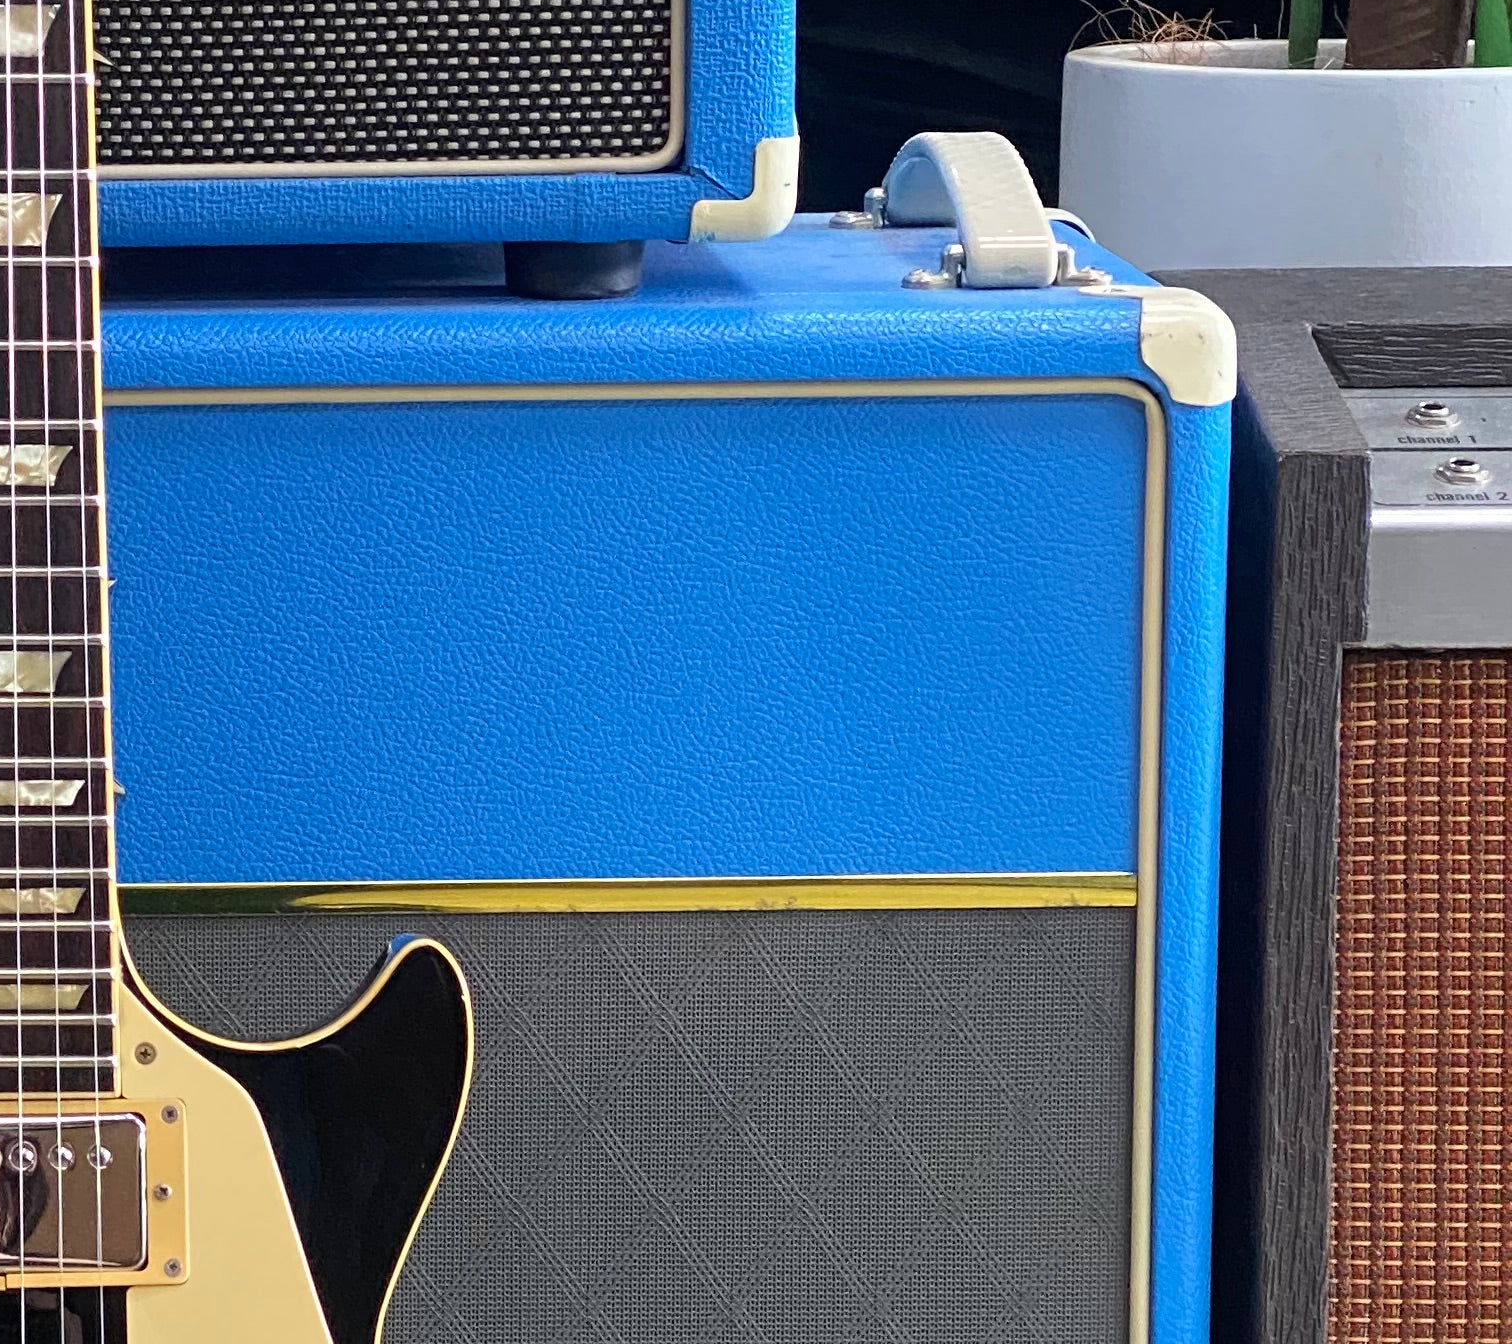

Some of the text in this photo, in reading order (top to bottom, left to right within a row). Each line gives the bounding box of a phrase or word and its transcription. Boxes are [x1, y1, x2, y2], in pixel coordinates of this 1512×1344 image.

[1397, 435, 1477, 444] channel 1
[1425, 491, 1510, 502] channel 2
